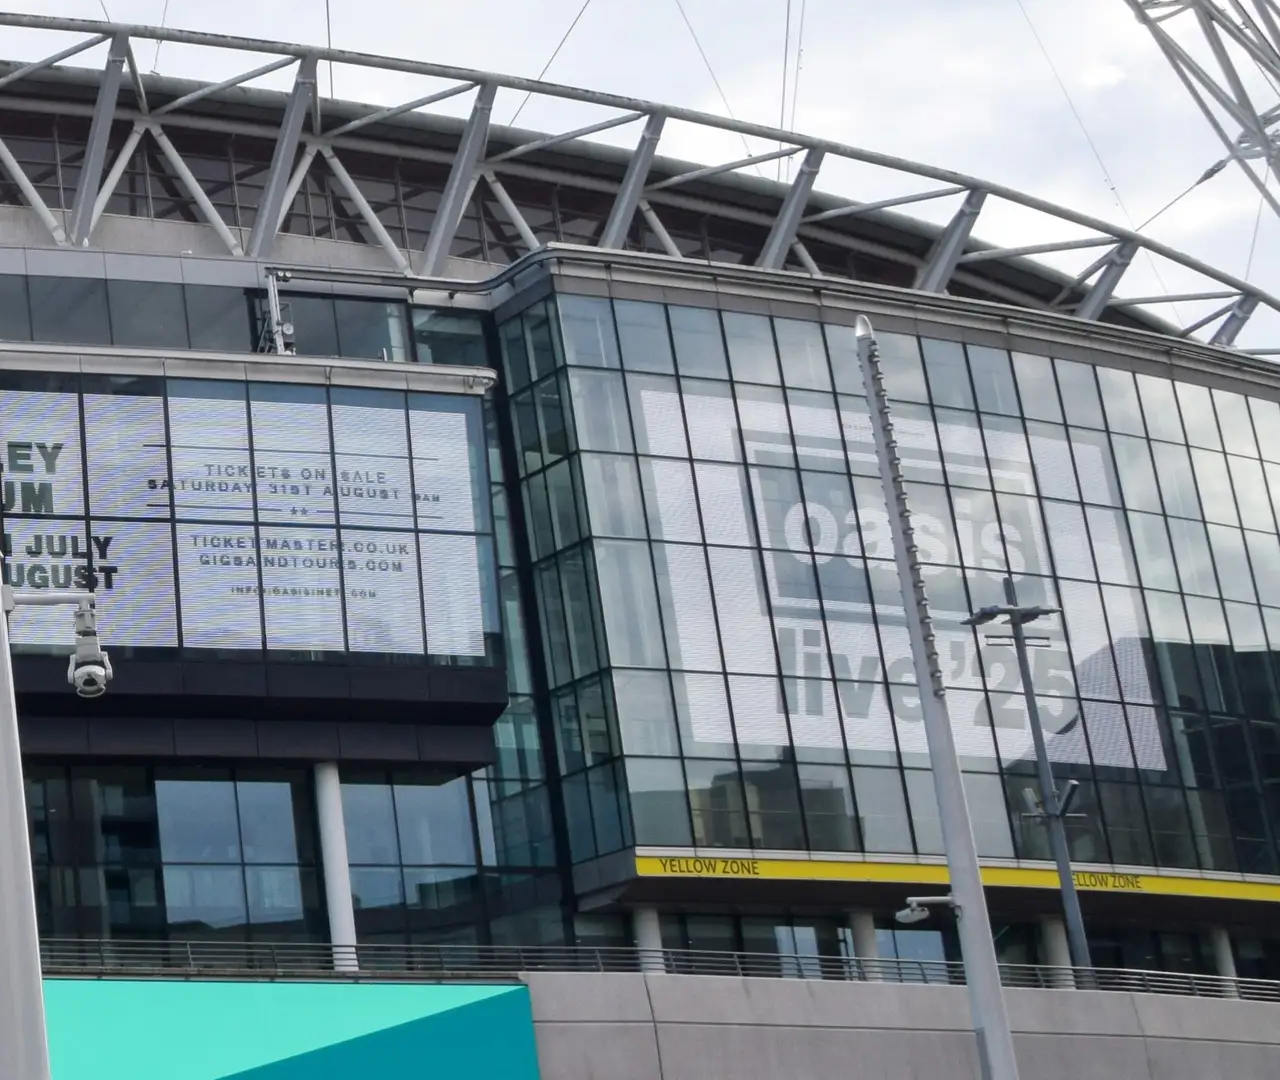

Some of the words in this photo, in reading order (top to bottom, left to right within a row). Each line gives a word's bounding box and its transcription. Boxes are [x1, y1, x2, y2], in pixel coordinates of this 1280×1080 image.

[205, 464, 290, 480] TICKETS
[301, 468, 326, 481] ON
[341, 471, 387, 484] SALE
[148, 478, 253, 493] SATURDAY
[323, 486, 400, 500] AUGUST
[26, 534, 114, 560] JULY
[784, 498, 1026, 584] oasis
[4, 562, 118, 589] UGUST
[776, 627, 924, 722] live
[948, 640, 1079, 735] '25
[659, 858, 717, 873] YELLOW
[721, 860, 760, 875] ZONE
[1111, 876, 1142, 889] ZONE
